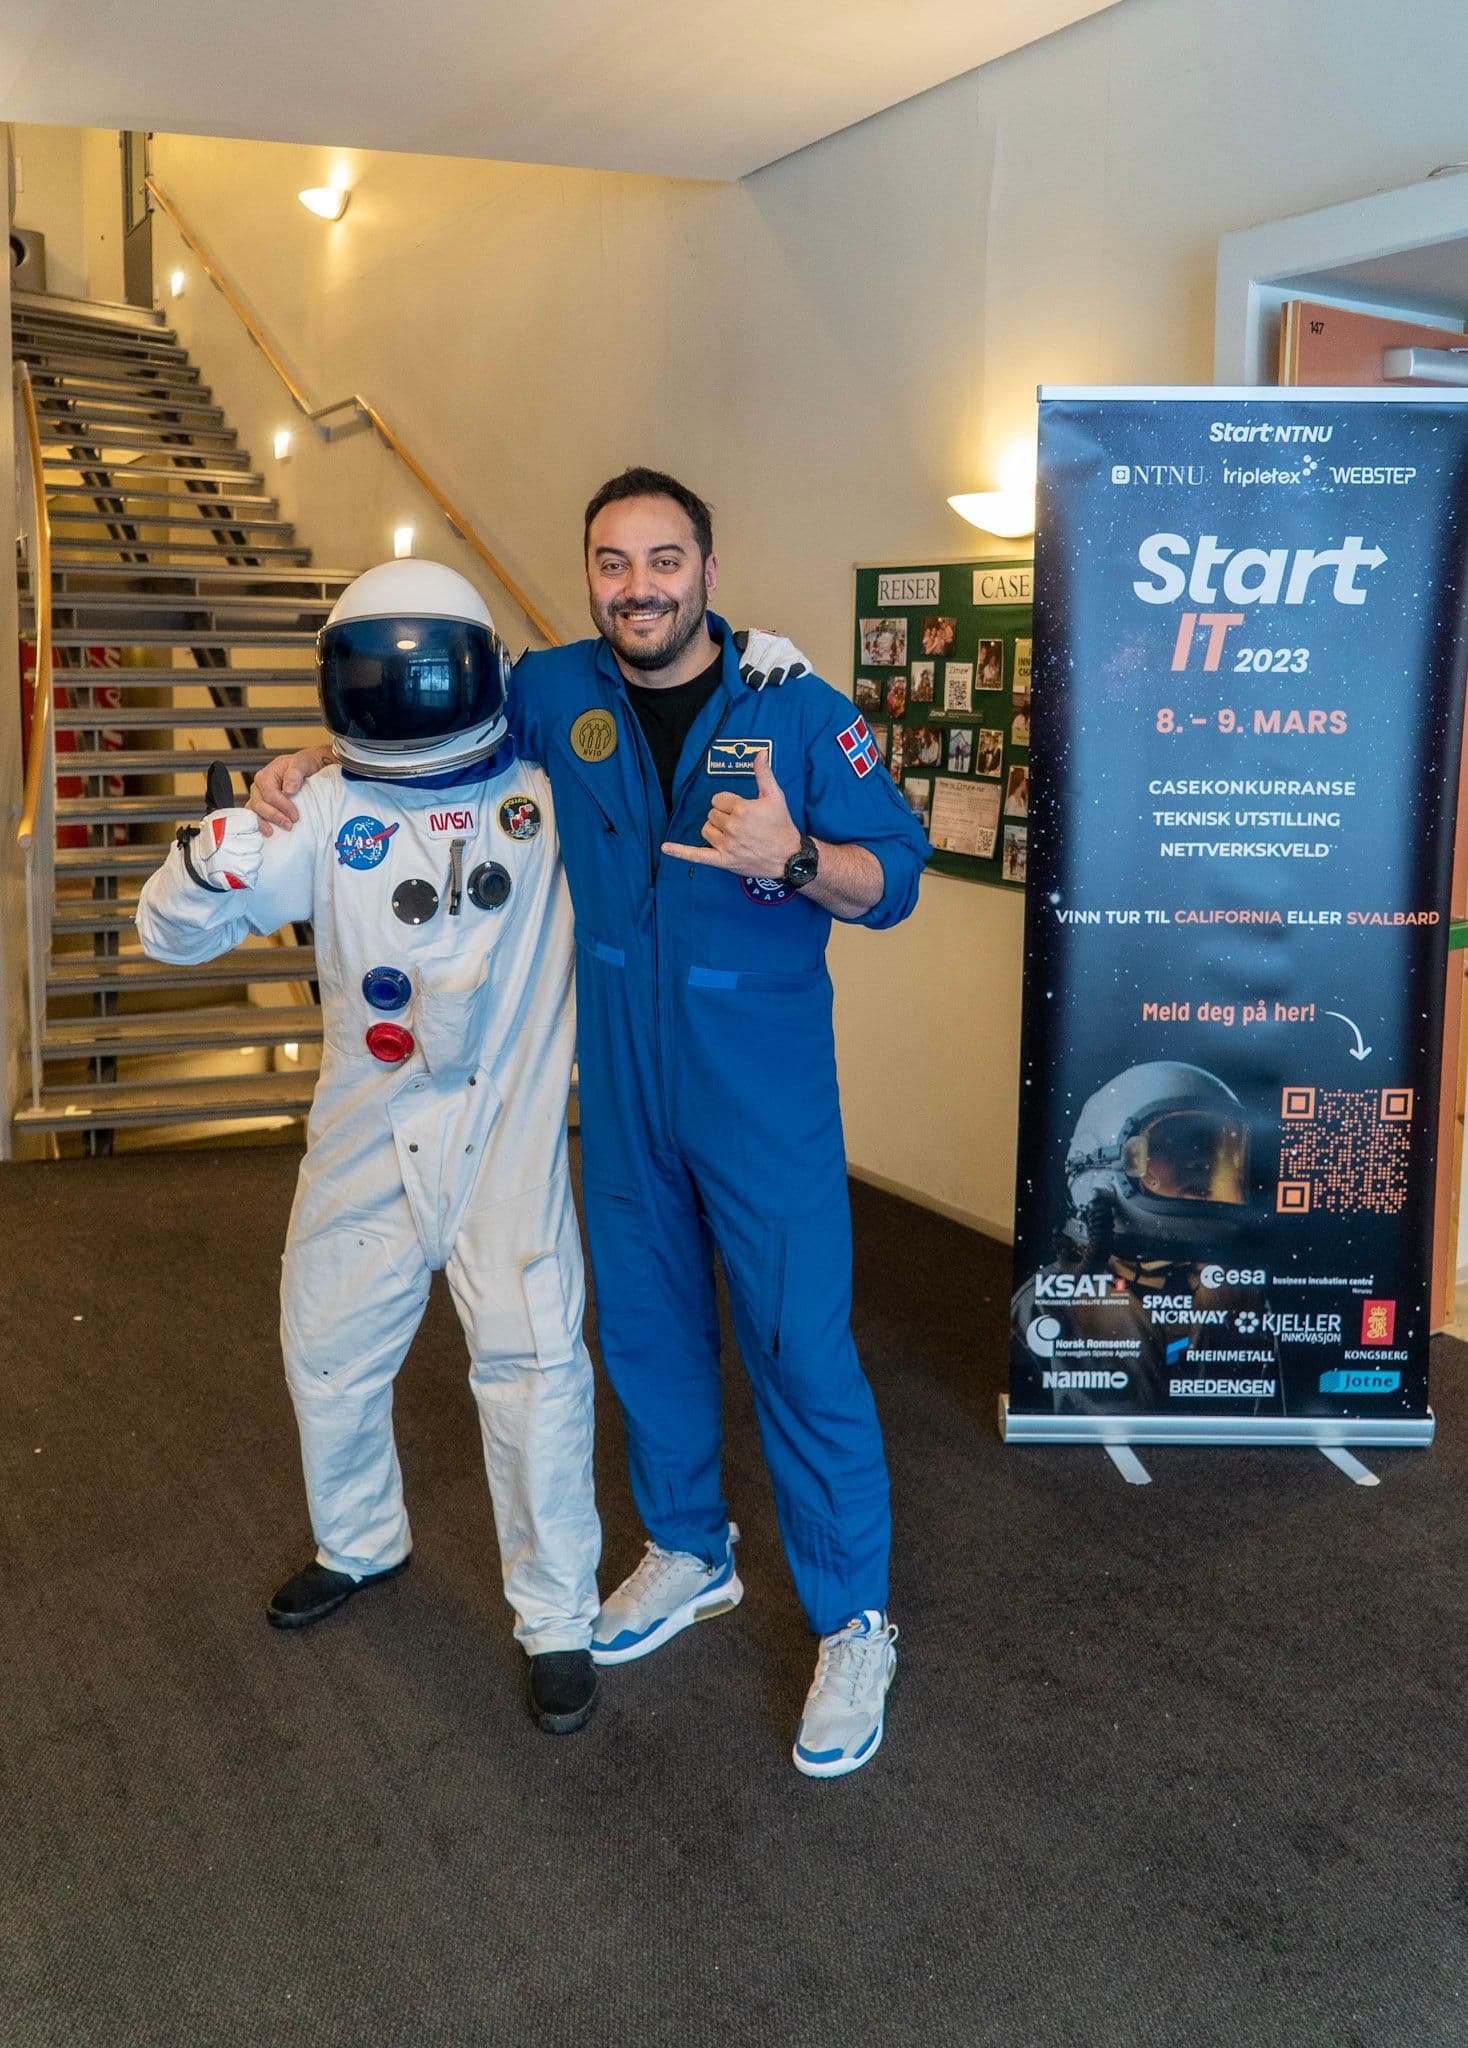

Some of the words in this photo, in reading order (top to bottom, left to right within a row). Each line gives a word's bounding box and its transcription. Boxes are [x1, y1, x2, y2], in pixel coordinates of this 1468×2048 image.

[1310, 321, 1324, 335] 147
[1133, 465, 1205, 486] NTNU
[1223, 467, 1301, 488] tripletex
[1329, 467, 1416, 485] WEBSTEP
[1133, 532, 1389, 606] Start
[880, 578, 937, 601] REISER
[981, 574, 1030, 599] CASE
[1170, 613, 1245, 672] IT
[1233, 648, 1310, 673] 2023
[1156, 708, 1183, 734] 8.
[1218, 708, 1243, 734] 9.
[1253, 709, 1348, 734] MARS
[1148, 779, 1356, 797] CASEKONKURRANSE
[429, 811, 474, 831] NASA
[1152, 811, 1230, 827] TEKNISK
[1235, 811, 1341, 828] UTSTILLING
[344, 834, 382, 851] NASA
[1160, 842, 1330, 858] NETTVERKSKVELD
[746, 877, 785, 901] SPAC
[1055, 909, 1101, 925] VINN
[1105, 910, 1140, 925] TUR
[1144, 910, 1170, 925] TIL
[1174, 910, 1283, 925] CALIFORNIA
[1287, 911, 1342, 925] ELLER
[1346, 911, 1440, 926] SVALBARD
[1142, 1002, 1190, 1022] Meld
[1196, 1002, 1235, 1027] deg
[1242, 1000, 1266, 1026] på
[1274, 1003, 1315, 1022] her!
[1035, 1273, 1113, 1298] KSAT
[1226, 1269, 1266, 1285] esa
[1272, 1275, 1307, 1285] business
[1308, 1276, 1347, 1285] incubation
[1349, 1277, 1374, 1286] centre
[1142, 1295, 1193, 1310] SPACE
[1151, 1310, 1228, 1325] NORWAY
[1262, 1314, 1341, 1335] KJELLER
[1055, 1339, 1085, 1349] Norsk
[1086, 1339, 1141, 1349] Romsenter
[1281, 1332, 1341, 1344] INNOVASJON
[1186, 1350, 1275, 1362] RHEINMETALL
[1344, 1350, 1409, 1360] KONGSBERG
[1042, 1370, 1129, 1389] Nammo
[1169, 1379, 1275, 1395] BREDENGEN
[1345, 1373, 1393, 1388] Jotne
